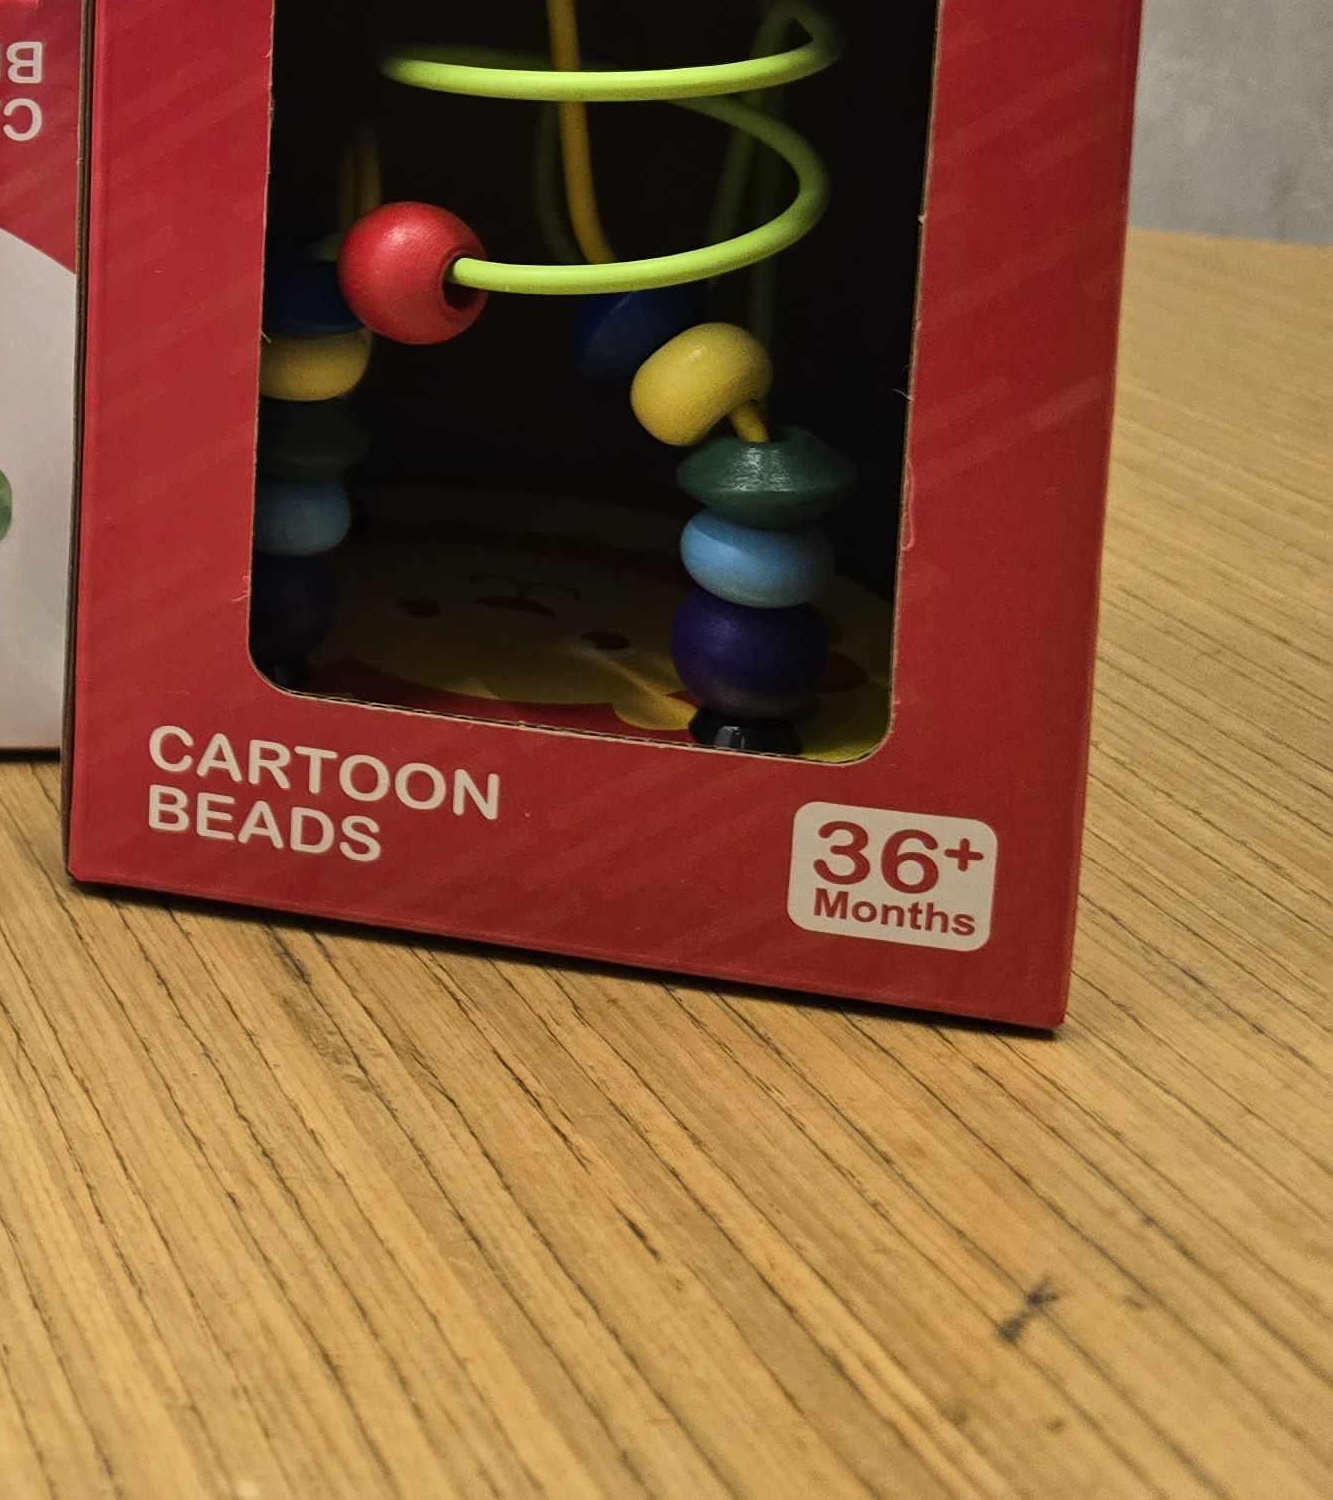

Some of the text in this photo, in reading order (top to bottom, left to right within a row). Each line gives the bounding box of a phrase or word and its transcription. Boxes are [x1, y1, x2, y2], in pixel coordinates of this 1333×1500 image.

[148, 725, 500, 820] CARTOON
[148, 784, 382, 862] BEADS
[813, 820, 984, 895] 36+
[813, 887, 976, 937] Months
